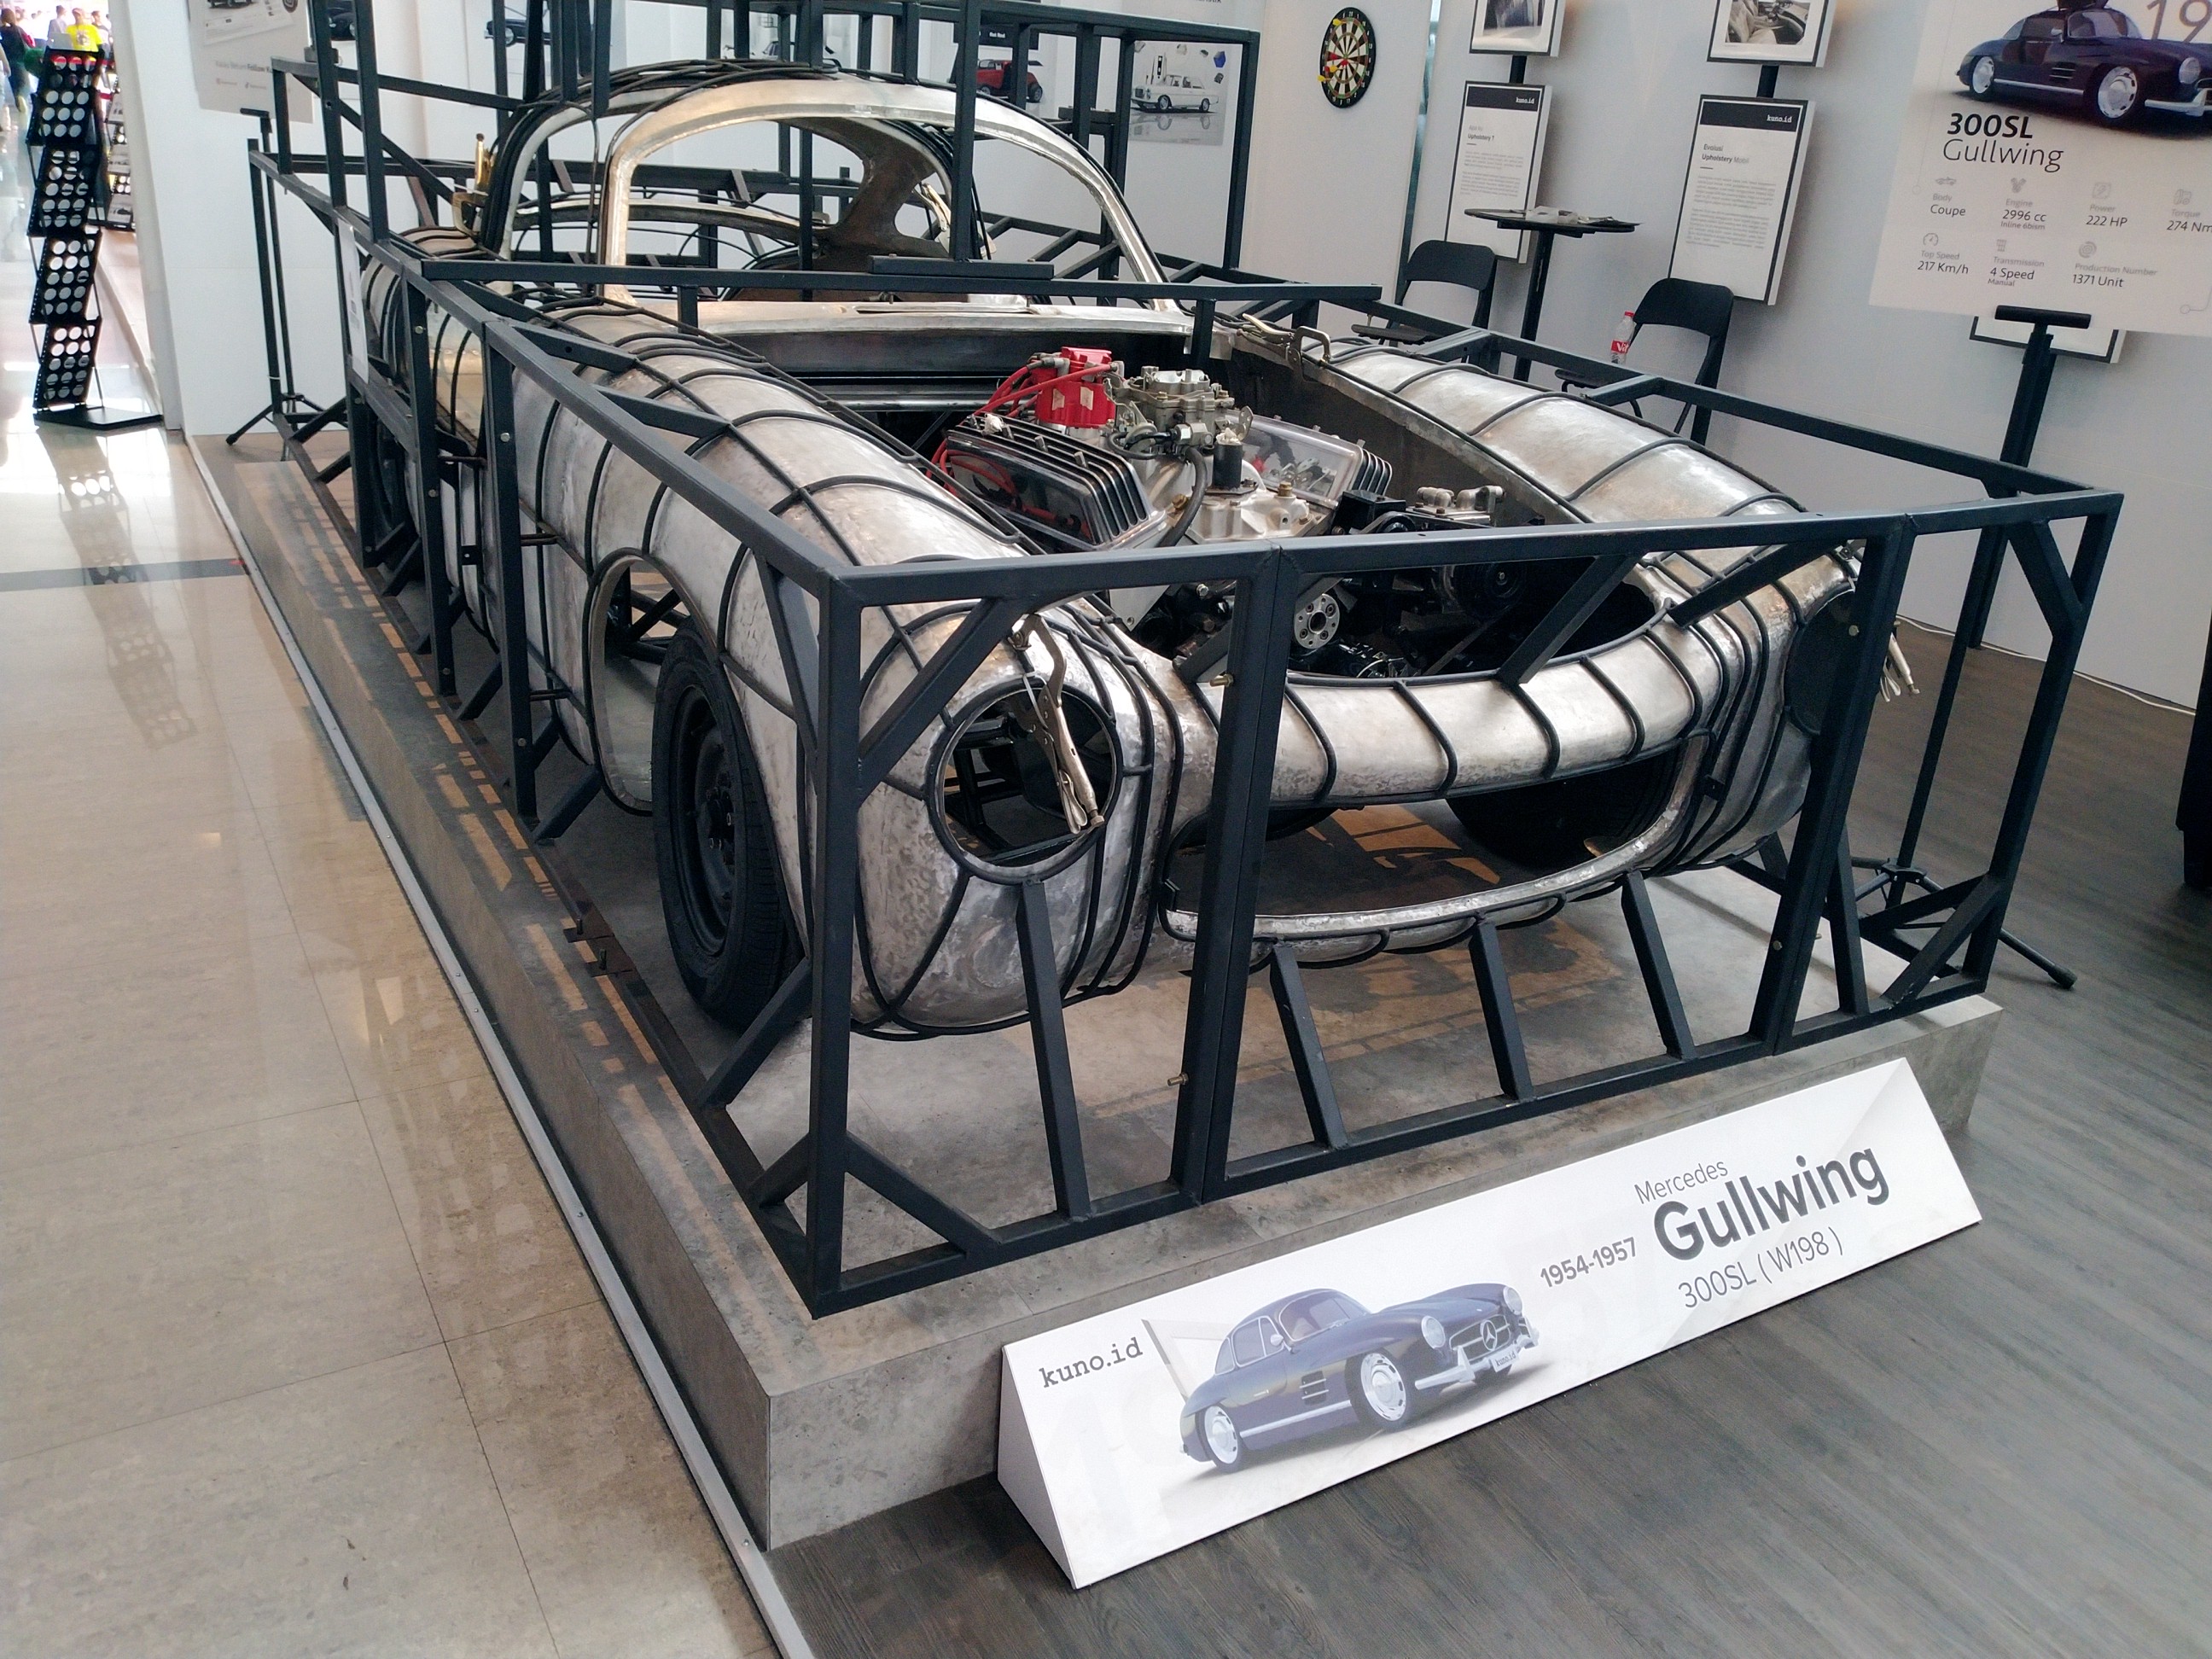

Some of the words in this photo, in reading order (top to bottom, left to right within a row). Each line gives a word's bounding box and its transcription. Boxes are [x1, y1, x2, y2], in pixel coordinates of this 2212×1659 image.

[1767, 114, 1793, 123] kuno.id
[1947, 113, 2033, 139] 300SL
[1702, 154, 1733, 164] Upholstery
[1943, 138, 2064, 173] Gullwing
[1932, 193, 1953, 202] Body
[2005, 198, 2034, 207] Engine
[1930, 204, 1966, 218] Coupe
[2089, 204, 2116, 212] Power
[2171, 208, 2201, 218] Torque
[2002, 209, 2031, 221] 2996
[2034, 213, 2046, 222] cc
[2086, 215, 2107, 226] 222
[2110, 217, 2128, 227] HP
[2000, 220, 2021, 230] Inline
[2166, 220, 2188, 231] 274
[1920, 250, 1935, 259] Top
[1936, 252, 1960, 260] Speed
[1993, 256, 2045, 267] Transmission
[1917, 260, 1936, 271] 217
[1937, 263, 1969, 275] Km/h
[1990, 267, 1997, 276] 4
[2000, 268, 2035, 280] Speed
[2075, 262, 2120, 273] Production
[2122, 266, 2157, 276] Number
[1988, 278, 2015, 287] Manual
[2073, 274, 2095, 285] 1371
[2098, 276, 2124, 288] Unit
[1633, 1160, 1729, 1205] Mercedes
[1653, 1148, 1890, 1261] Gullwing
[1540, 1237, 1638, 1290] 1954-1957
[1678, 1260, 1758, 1309] 300SL
[1038, 1336, 1144, 1388] kuno.id
[1494, 1352, 1516, 1367] kuno.id
